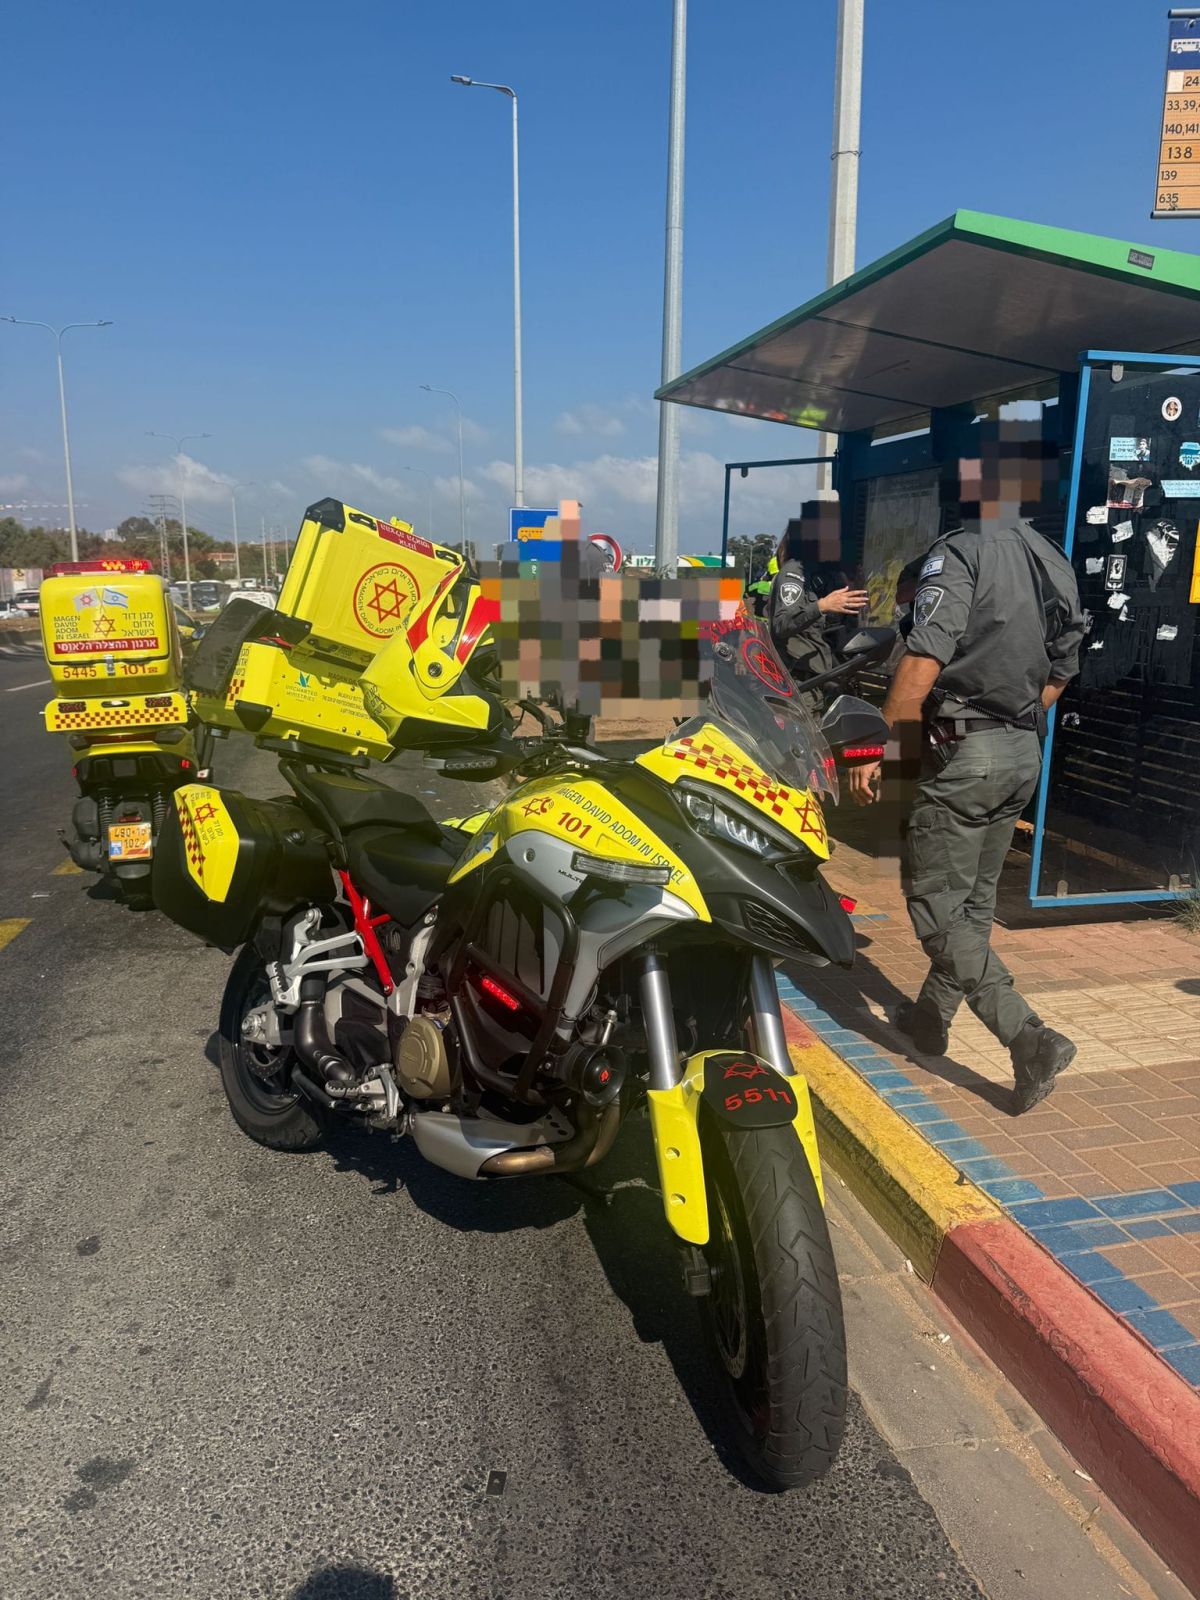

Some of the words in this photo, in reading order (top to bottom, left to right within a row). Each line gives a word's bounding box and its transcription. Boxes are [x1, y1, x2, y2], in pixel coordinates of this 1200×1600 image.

[1168, 146, 1192, 159] 138
[1161, 170, 1178, 181] 139
[1158, 193, 1179, 204] 635
[123, 612, 138, 620] דוד
[139, 612, 153, 621] מגן
[133, 620, 155, 628] אדום
[121, 628, 155, 638] בישראל
[57, 641, 93, 652] הלאומי
[95, 640, 129, 650] ההצלה
[131, 639, 157, 650] ארגון
[63, 666, 97, 679] 5445
[121, 664, 146, 676] 101
[556, 787, 586, 805] MAGEN
[582, 799, 612, 824] DAVID
[608, 820, 641, 848] ADOM
[638, 842, 653, 857] IN
[557, 812, 593, 840] 101
[724, 1087, 792, 1111] 5511
